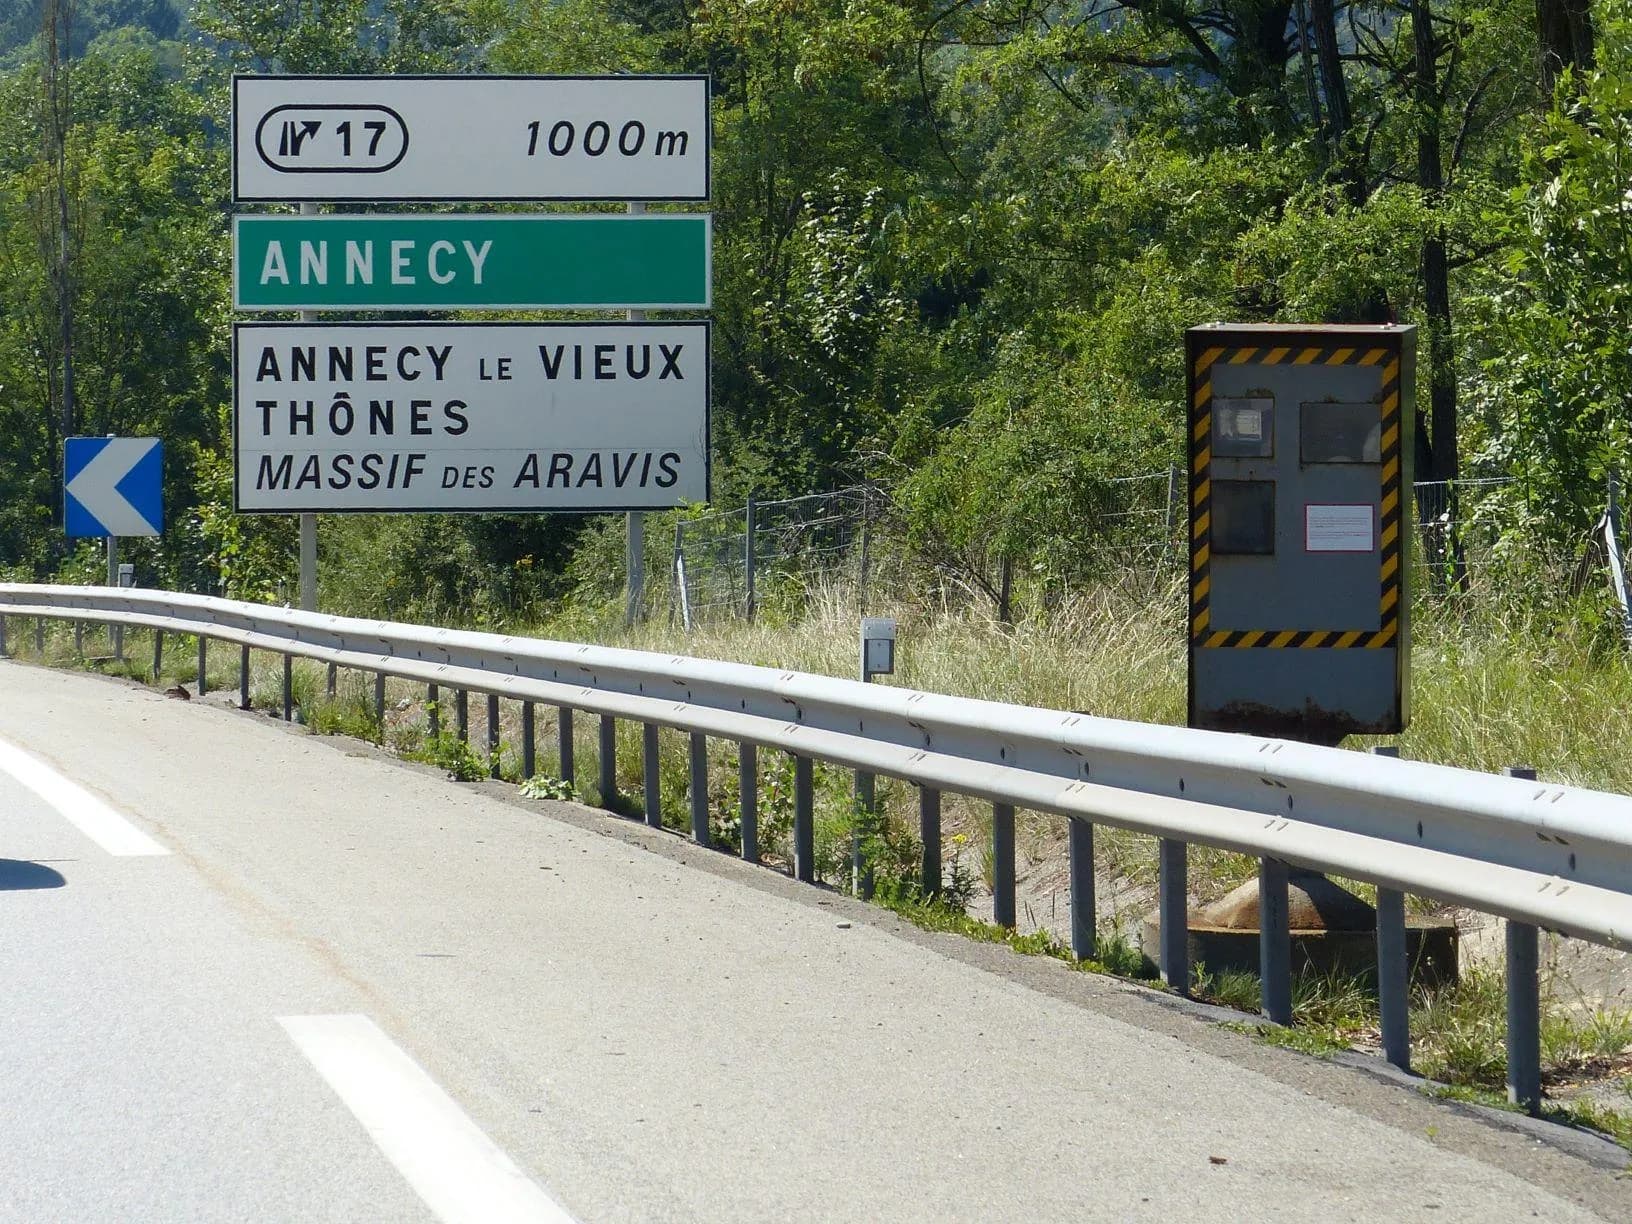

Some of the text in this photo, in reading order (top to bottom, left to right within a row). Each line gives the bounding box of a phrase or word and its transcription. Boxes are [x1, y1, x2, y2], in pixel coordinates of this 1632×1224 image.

[336, 121, 386, 157] 17
[260, 240, 493, 286] ANNECY
[256, 344, 685, 382] ANNECY LE VIEUX
[256, 391, 469, 436] THÔNES
[256, 452, 682, 490] MASSIF DES ARAVIS
